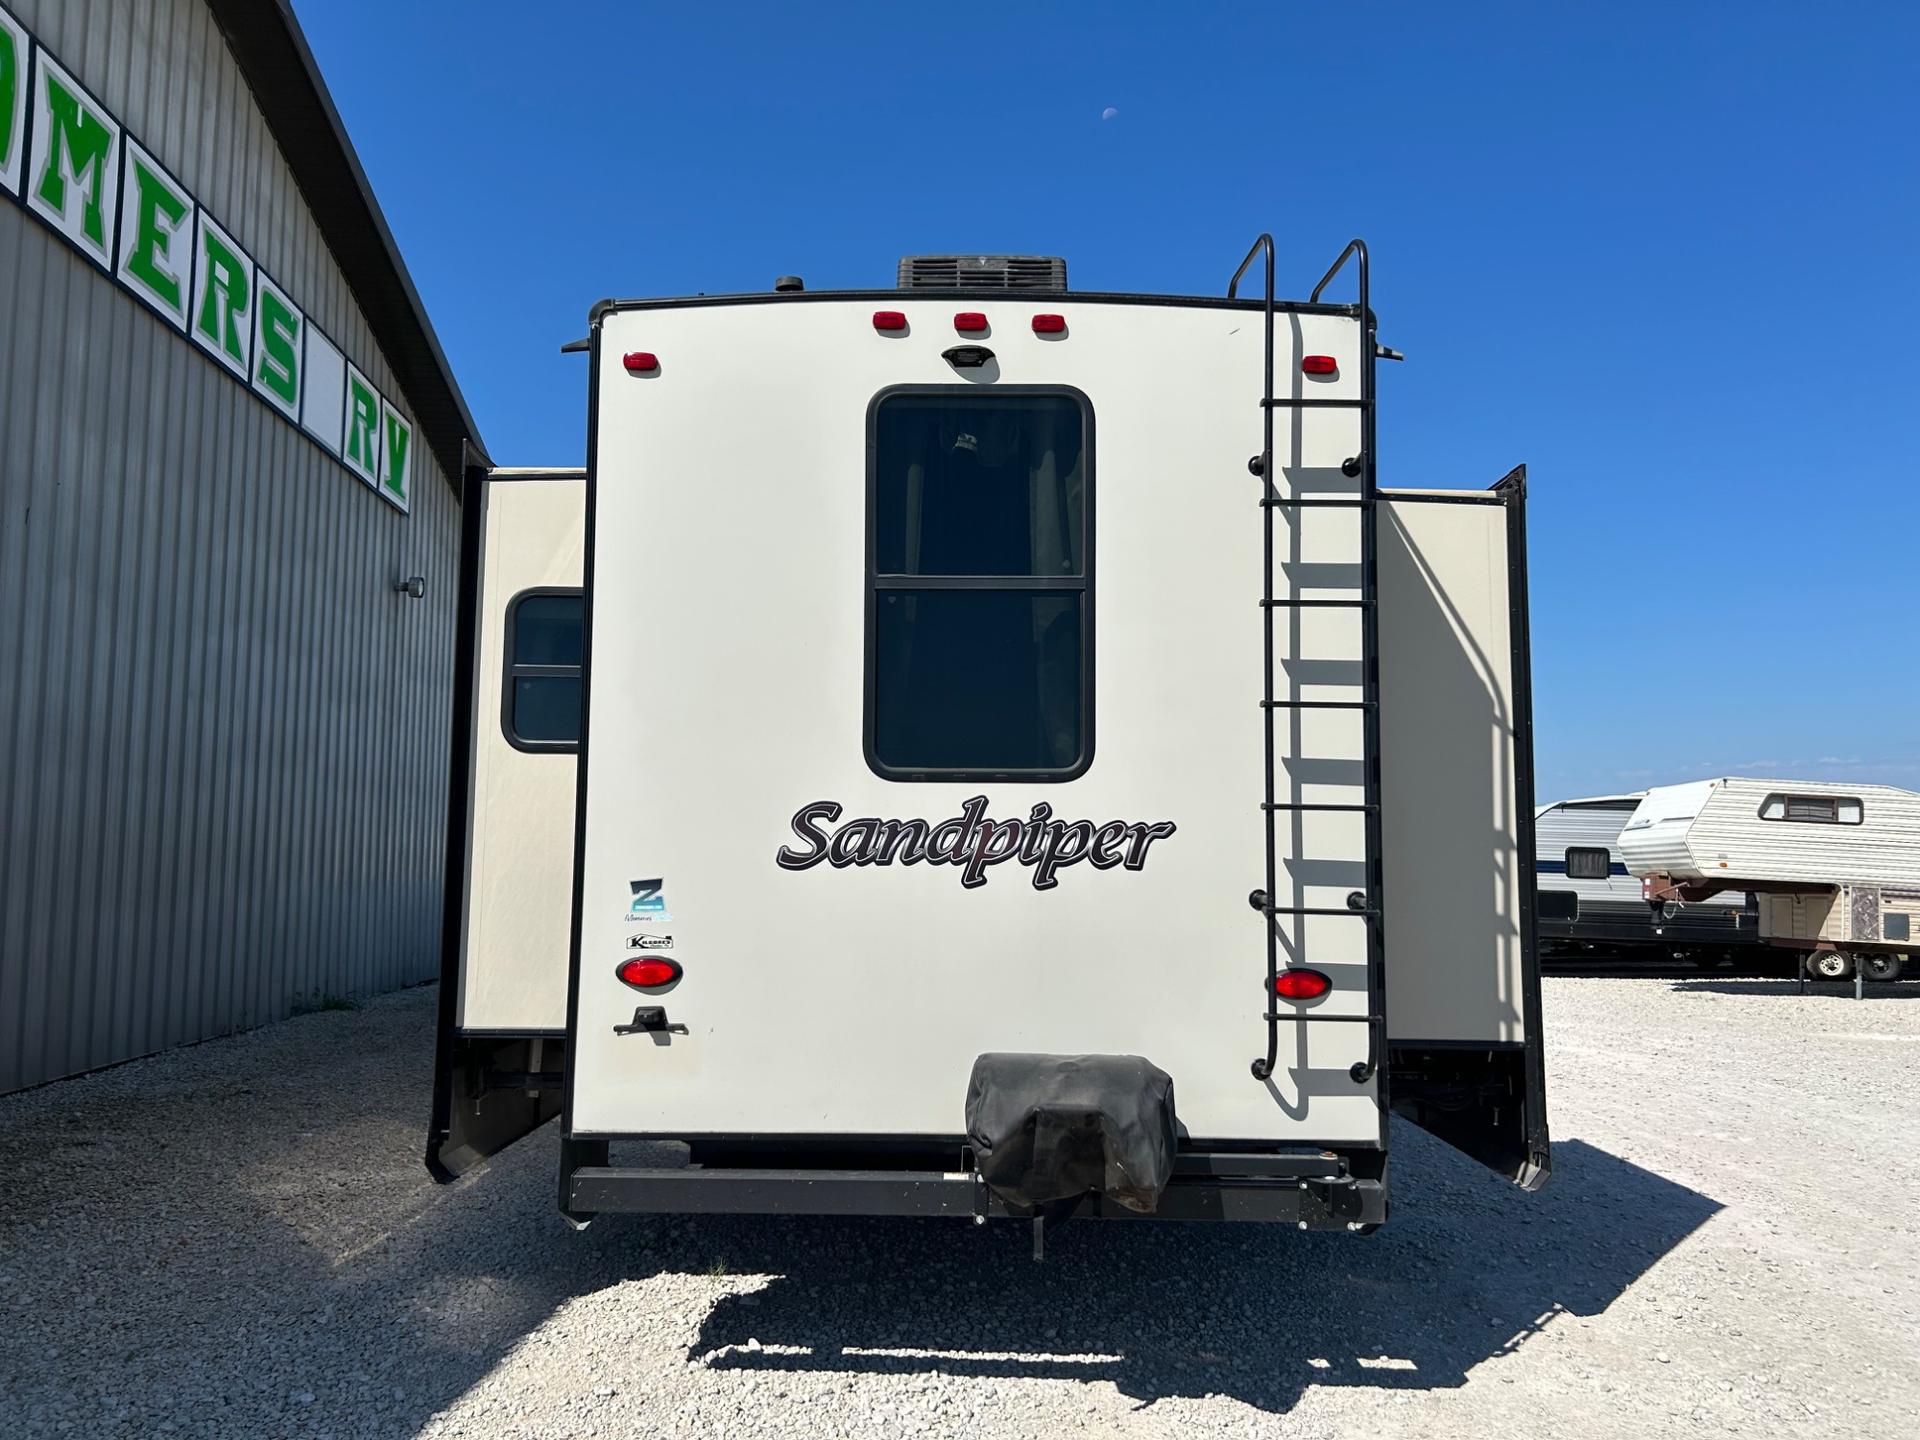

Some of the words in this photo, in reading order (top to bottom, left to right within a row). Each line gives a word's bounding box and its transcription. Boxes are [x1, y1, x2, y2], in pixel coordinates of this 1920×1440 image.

[0, 24, 302, 409] MERS
[350, 372, 411, 500] RV
[777, 795, 1177, 891] Sandpiper
